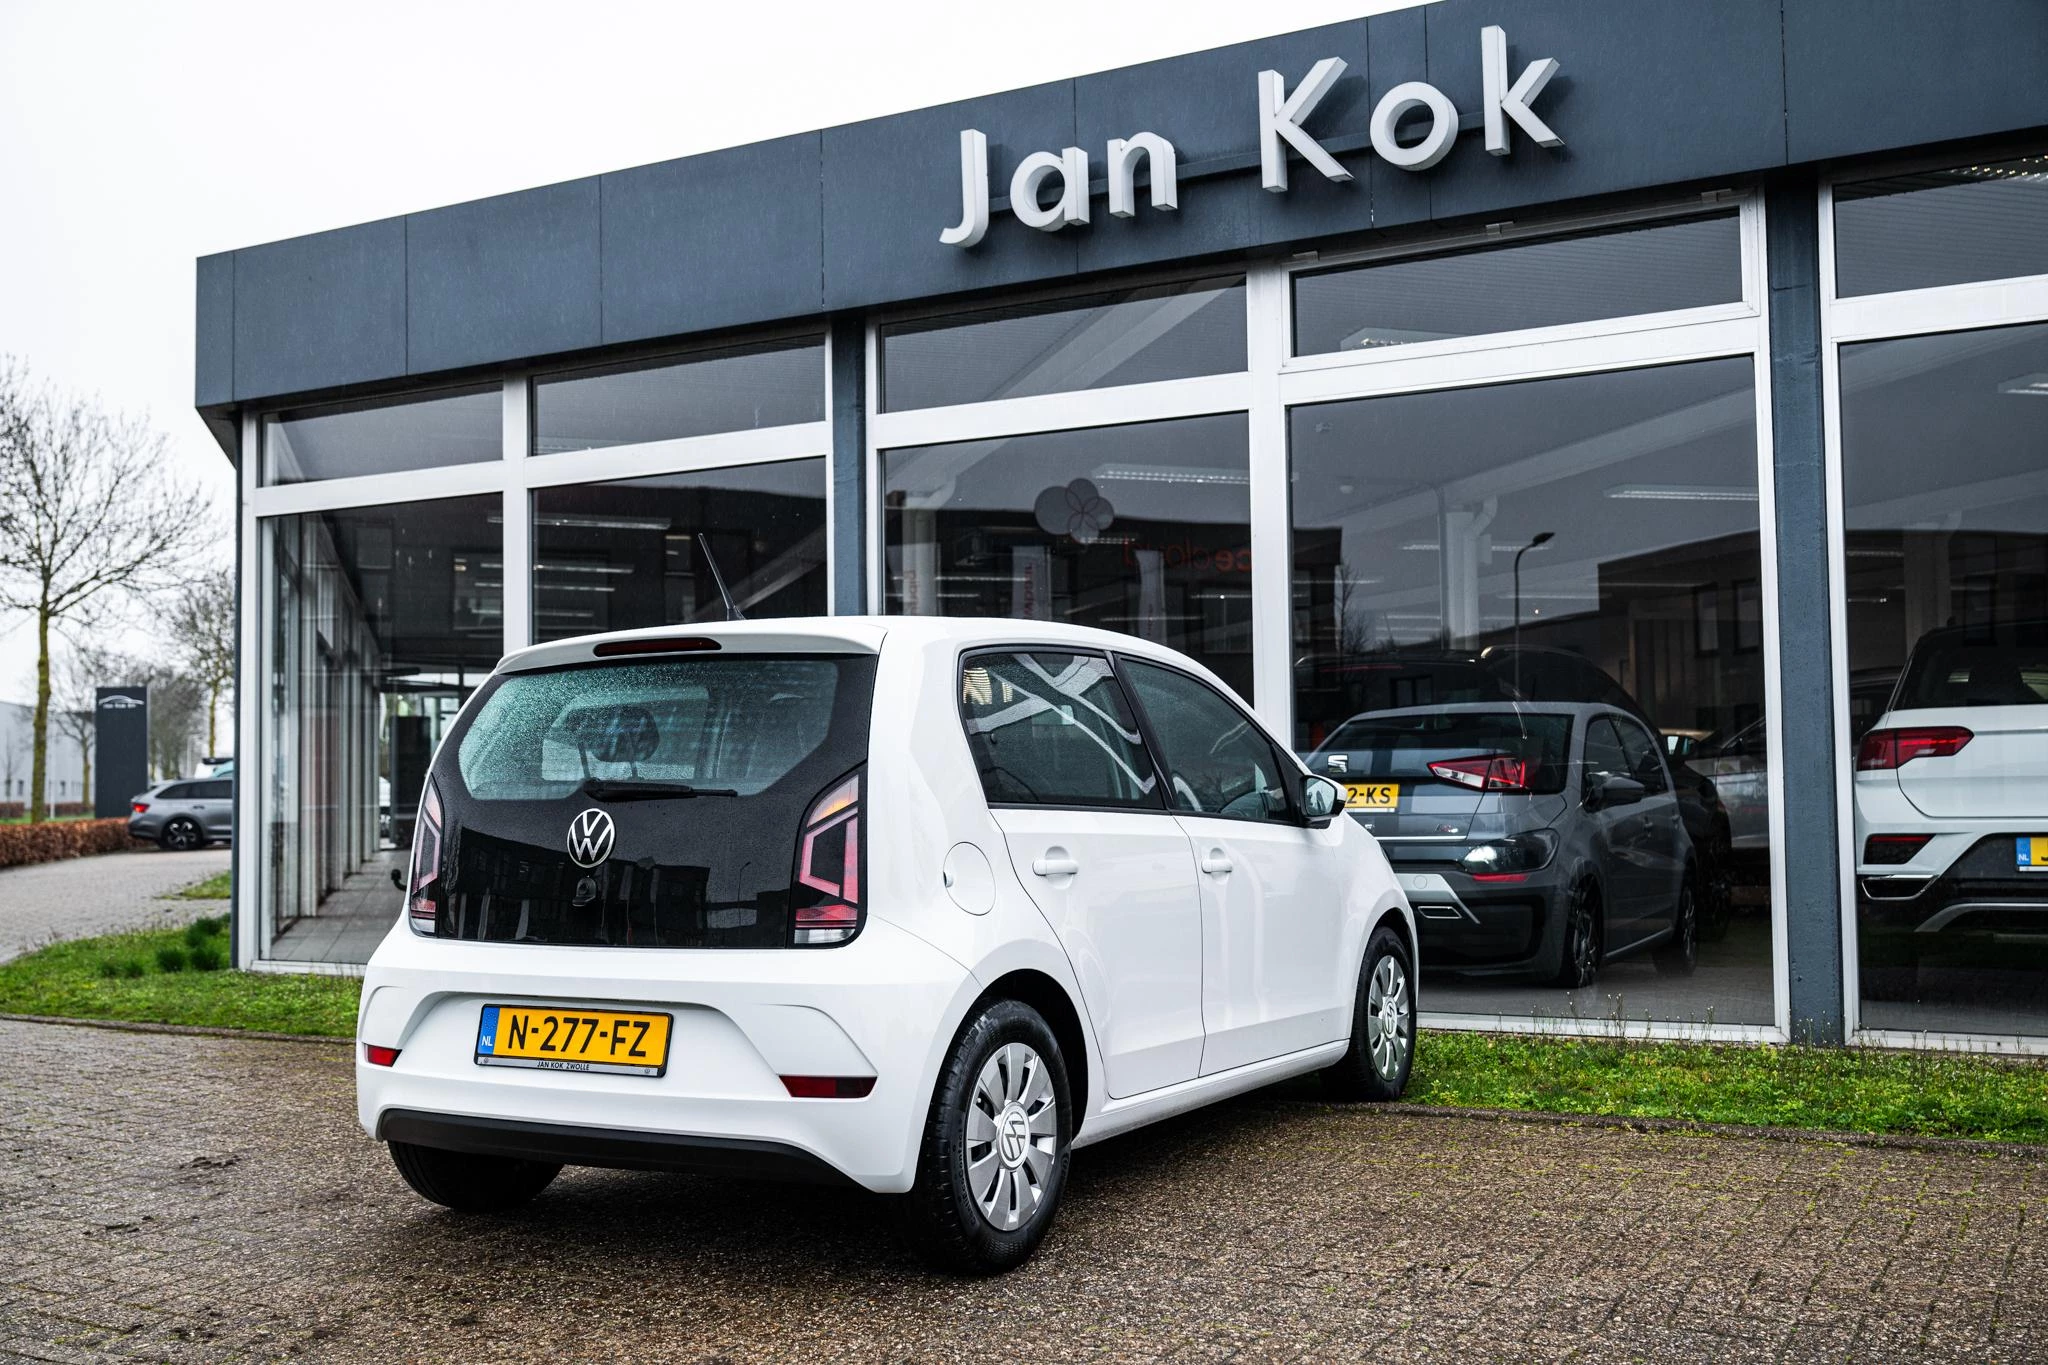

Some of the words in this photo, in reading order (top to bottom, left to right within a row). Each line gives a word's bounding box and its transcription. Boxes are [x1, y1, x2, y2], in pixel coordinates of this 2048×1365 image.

[939, 128, 1178, 248] Jan
[1257, 24, 1566, 192] Kok
[2018, 853, 2029, 861] NL
[481, 1035, 493, 1047] NL
[508, 1014, 651, 1058] N-277-FZ
[536, 1060, 549, 1068] JAN
[565, 1062, 590, 1071] ZWOLLE
